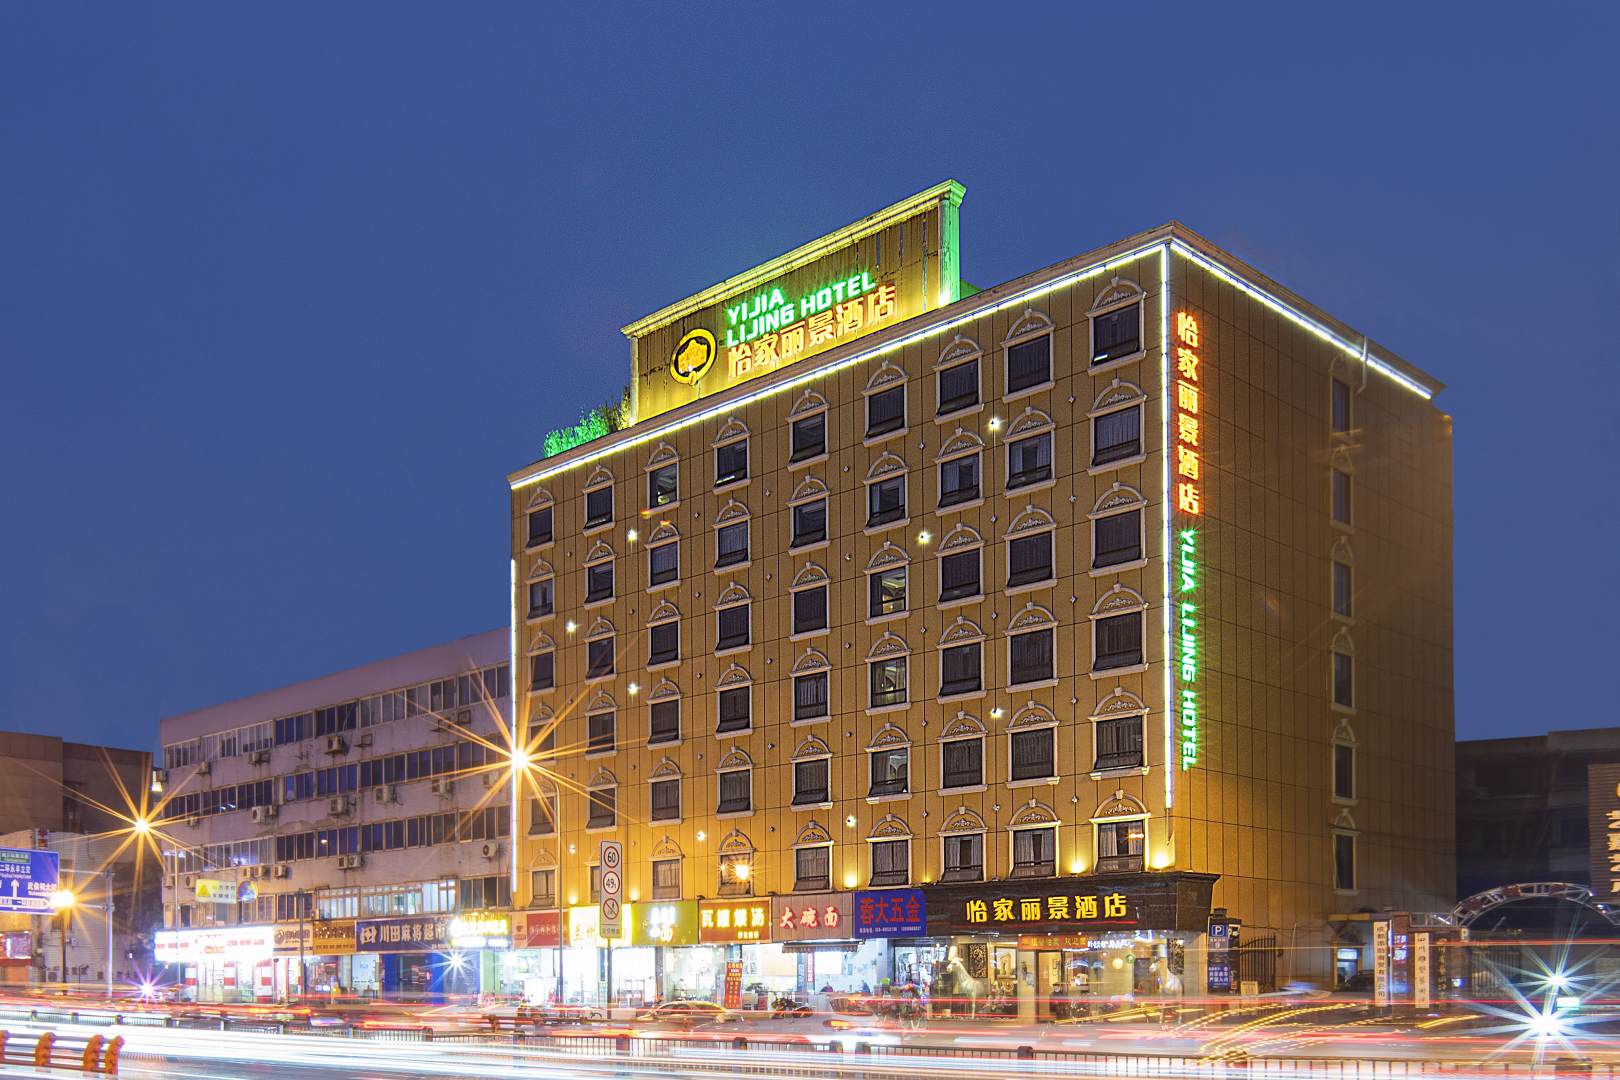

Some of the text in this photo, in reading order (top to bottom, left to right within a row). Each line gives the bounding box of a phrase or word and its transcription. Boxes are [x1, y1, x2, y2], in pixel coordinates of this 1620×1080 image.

[727, 288, 784, 326] YIJIA
[727, 272, 876, 348] LIJING HOTEL
[727, 286, 896, 378] 怡家丽景酒店
[1177, 312, 1198, 514] 怡家丽景酒店
[1180, 530, 1197, 771] YIJIA LIJING HOTEL
[607, 851, 616, 863] 60
[780, 906, 839, 929] 大碗面
[966, 893, 1127, 923] 怡家丽景酒店
